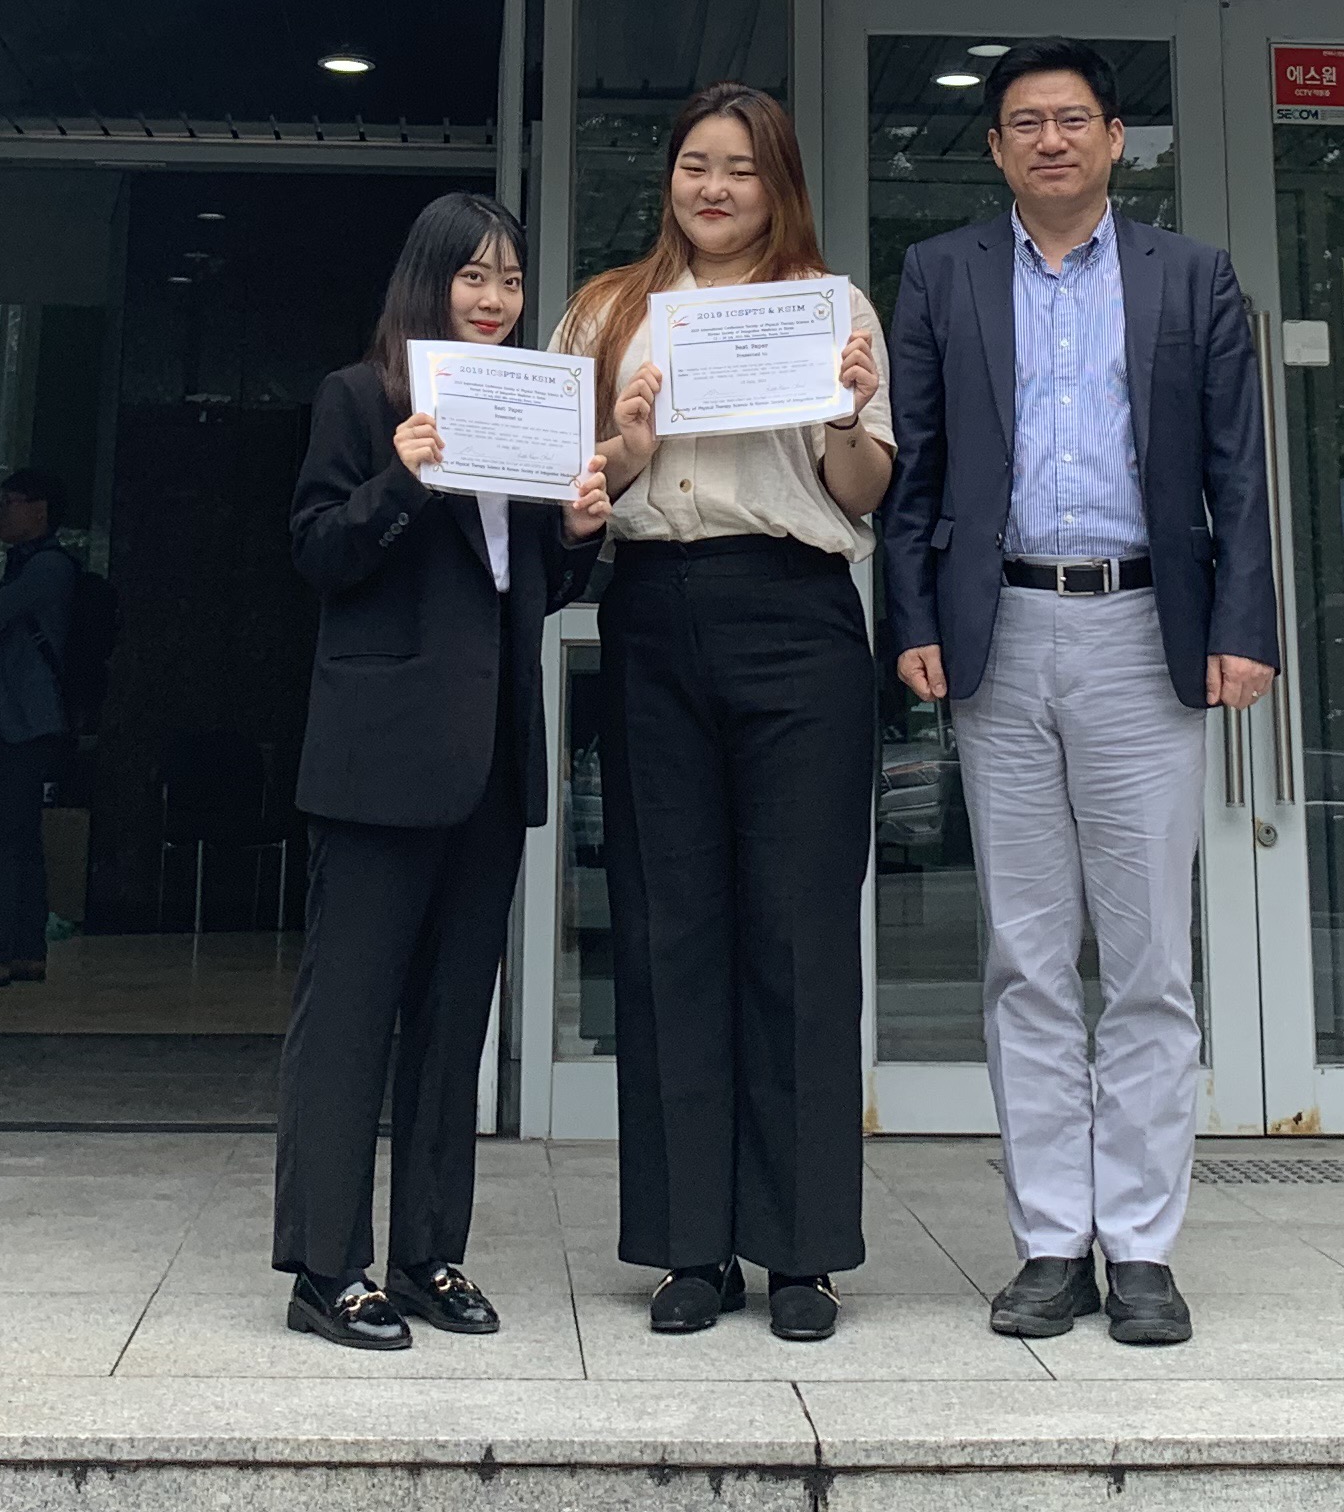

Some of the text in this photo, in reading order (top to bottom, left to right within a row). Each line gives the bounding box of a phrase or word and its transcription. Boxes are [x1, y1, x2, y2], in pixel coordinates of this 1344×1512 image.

[1286, 65, 1337, 86] 에스원
[1276, 108, 1319, 120] SECOM
[726, 309, 765, 318] ICSPTS
[778, 305, 806, 313] KSIM
[460, 366, 483, 374] 2019
